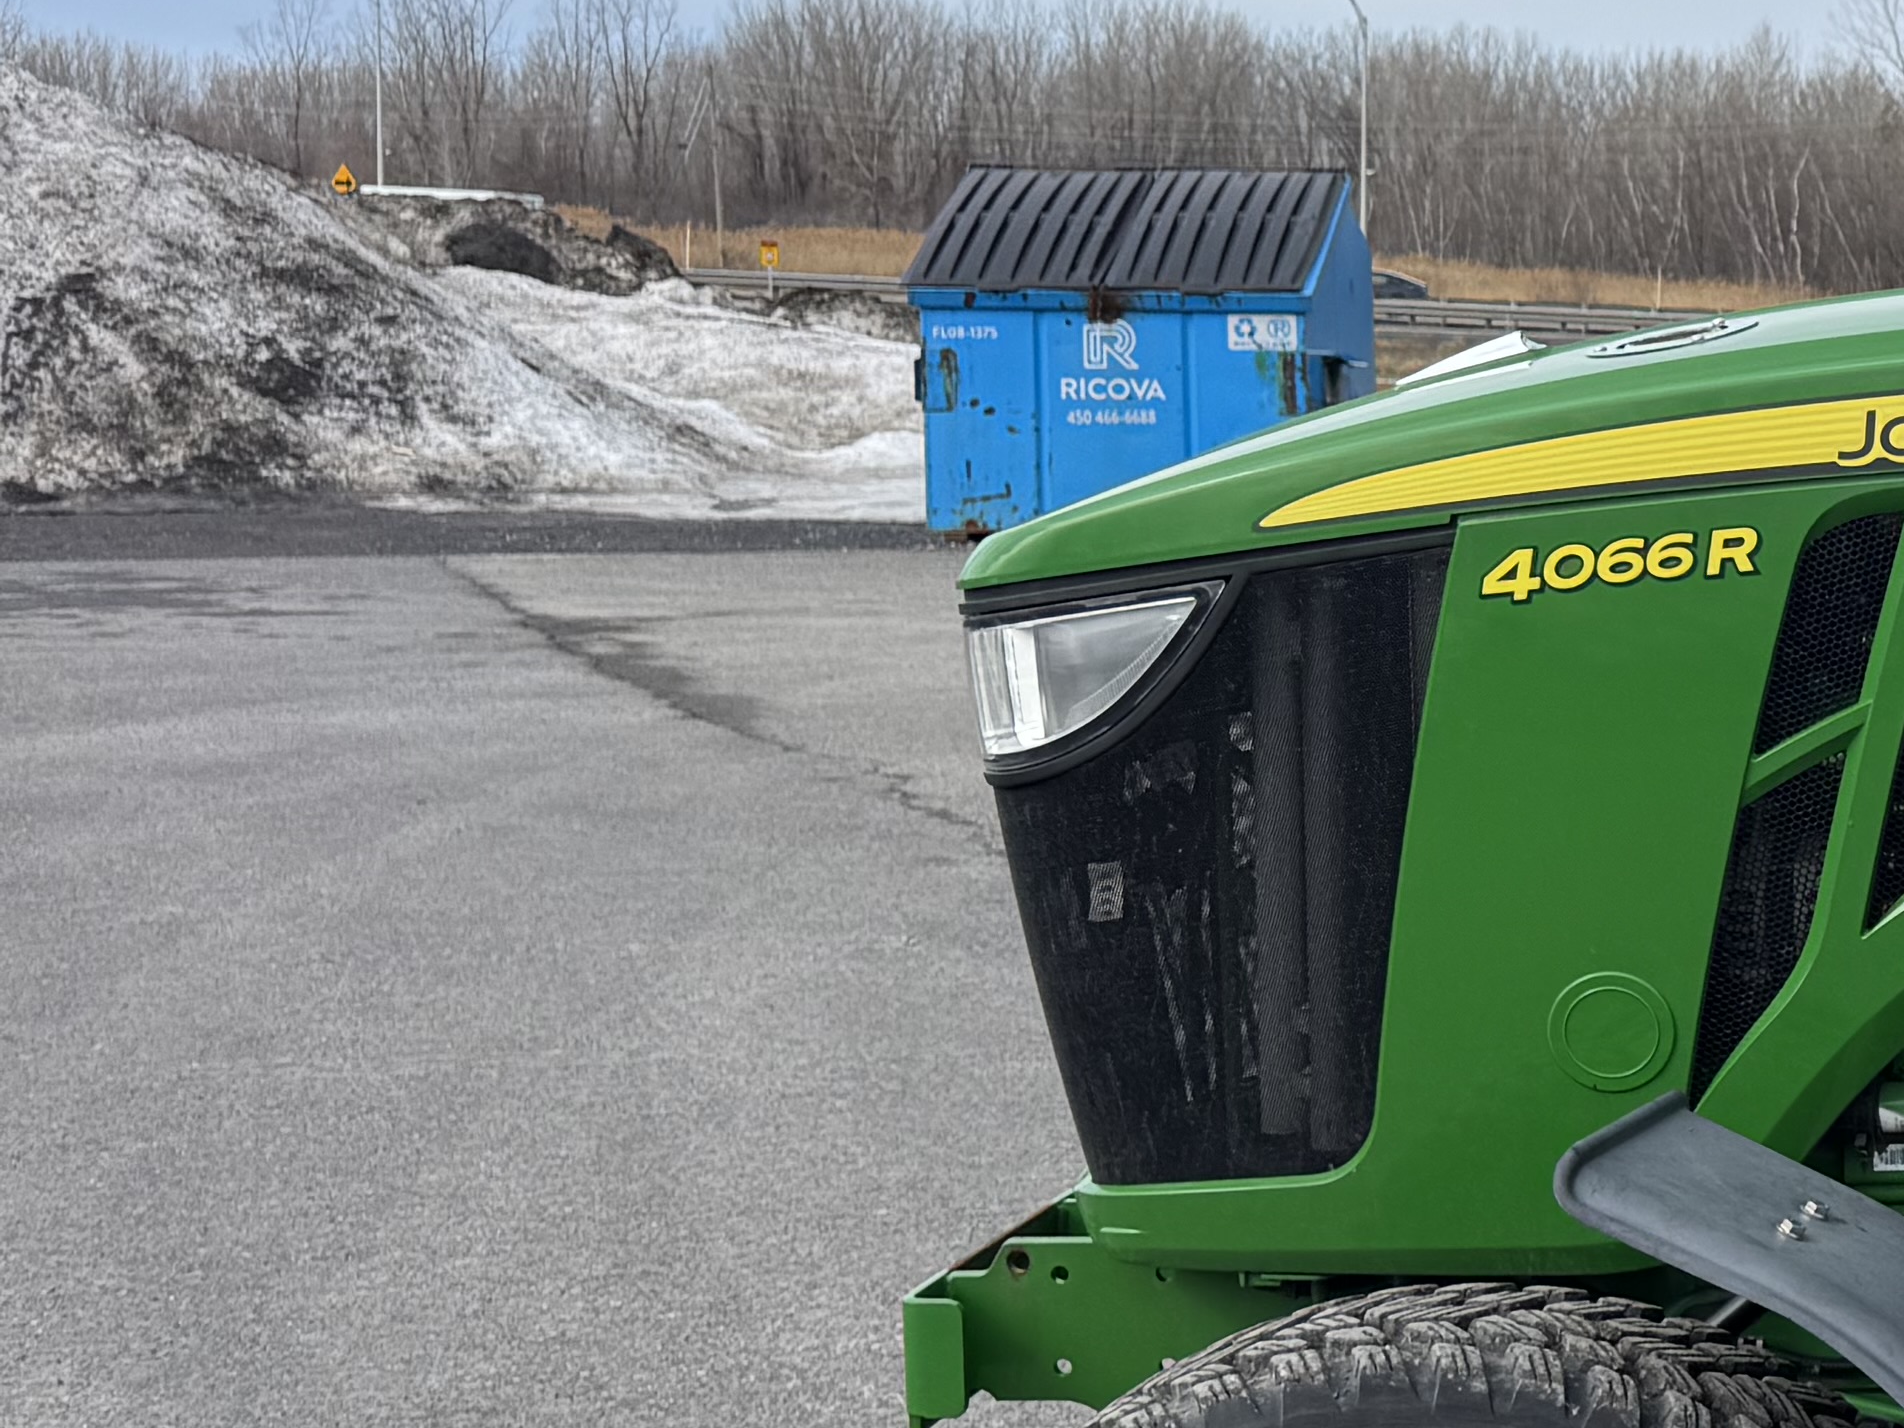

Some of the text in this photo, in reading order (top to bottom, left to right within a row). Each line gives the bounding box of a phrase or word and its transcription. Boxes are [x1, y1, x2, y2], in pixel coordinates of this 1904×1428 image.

[1061, 378, 1165, 401] RICOVA
[1067, 410, 1091, 425] 450
[1482, 527, 1758, 601] 4066 R
